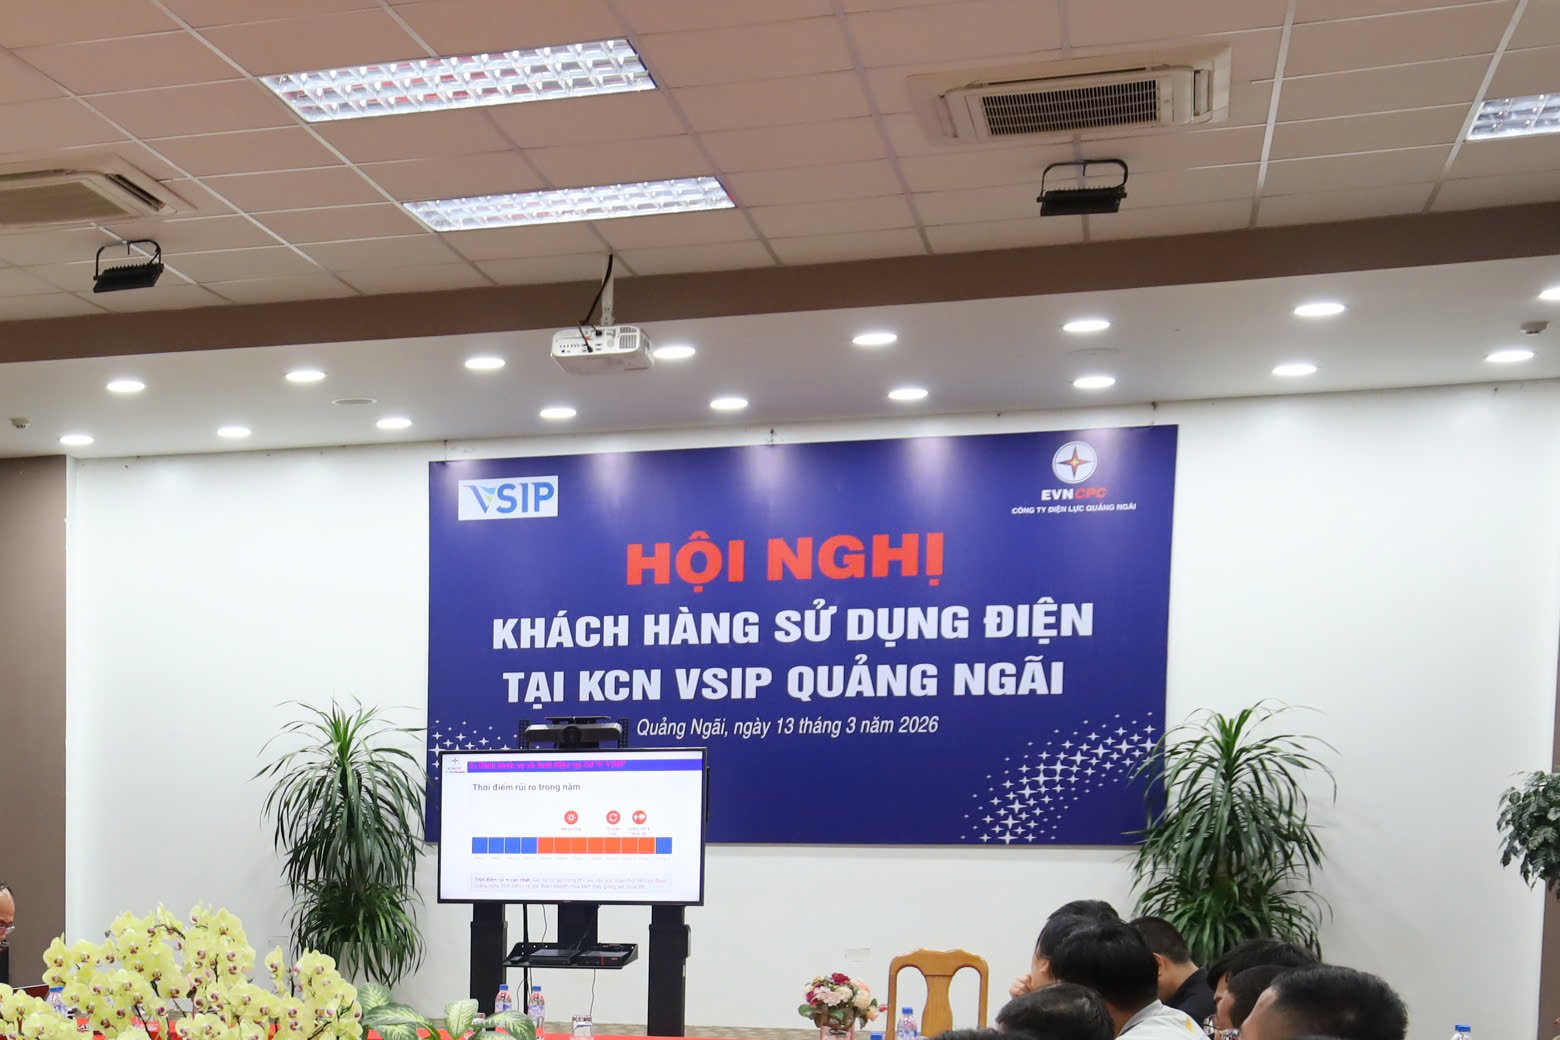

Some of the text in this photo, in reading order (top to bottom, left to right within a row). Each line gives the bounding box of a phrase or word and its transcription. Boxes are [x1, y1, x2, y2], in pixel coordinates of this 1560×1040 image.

[463, 482, 555, 514] VSIP
[1011, 505, 1035, 514] CÔNG
[1036, 506, 1047, 514] TY
[627, 530, 944, 592] HỘI NGHỊ
[493, 596, 1094, 650] KHÁCH HÀNG SỬ DỤNG ĐIỆN
[503, 653, 1064, 709] TẠI KCN VSIP QUẢNG NGÃI
[636, 715, 939, 739] Quảng Ngãi, ngày 13 tháng 3 năm 2026
[538, 783, 561, 793] trong
